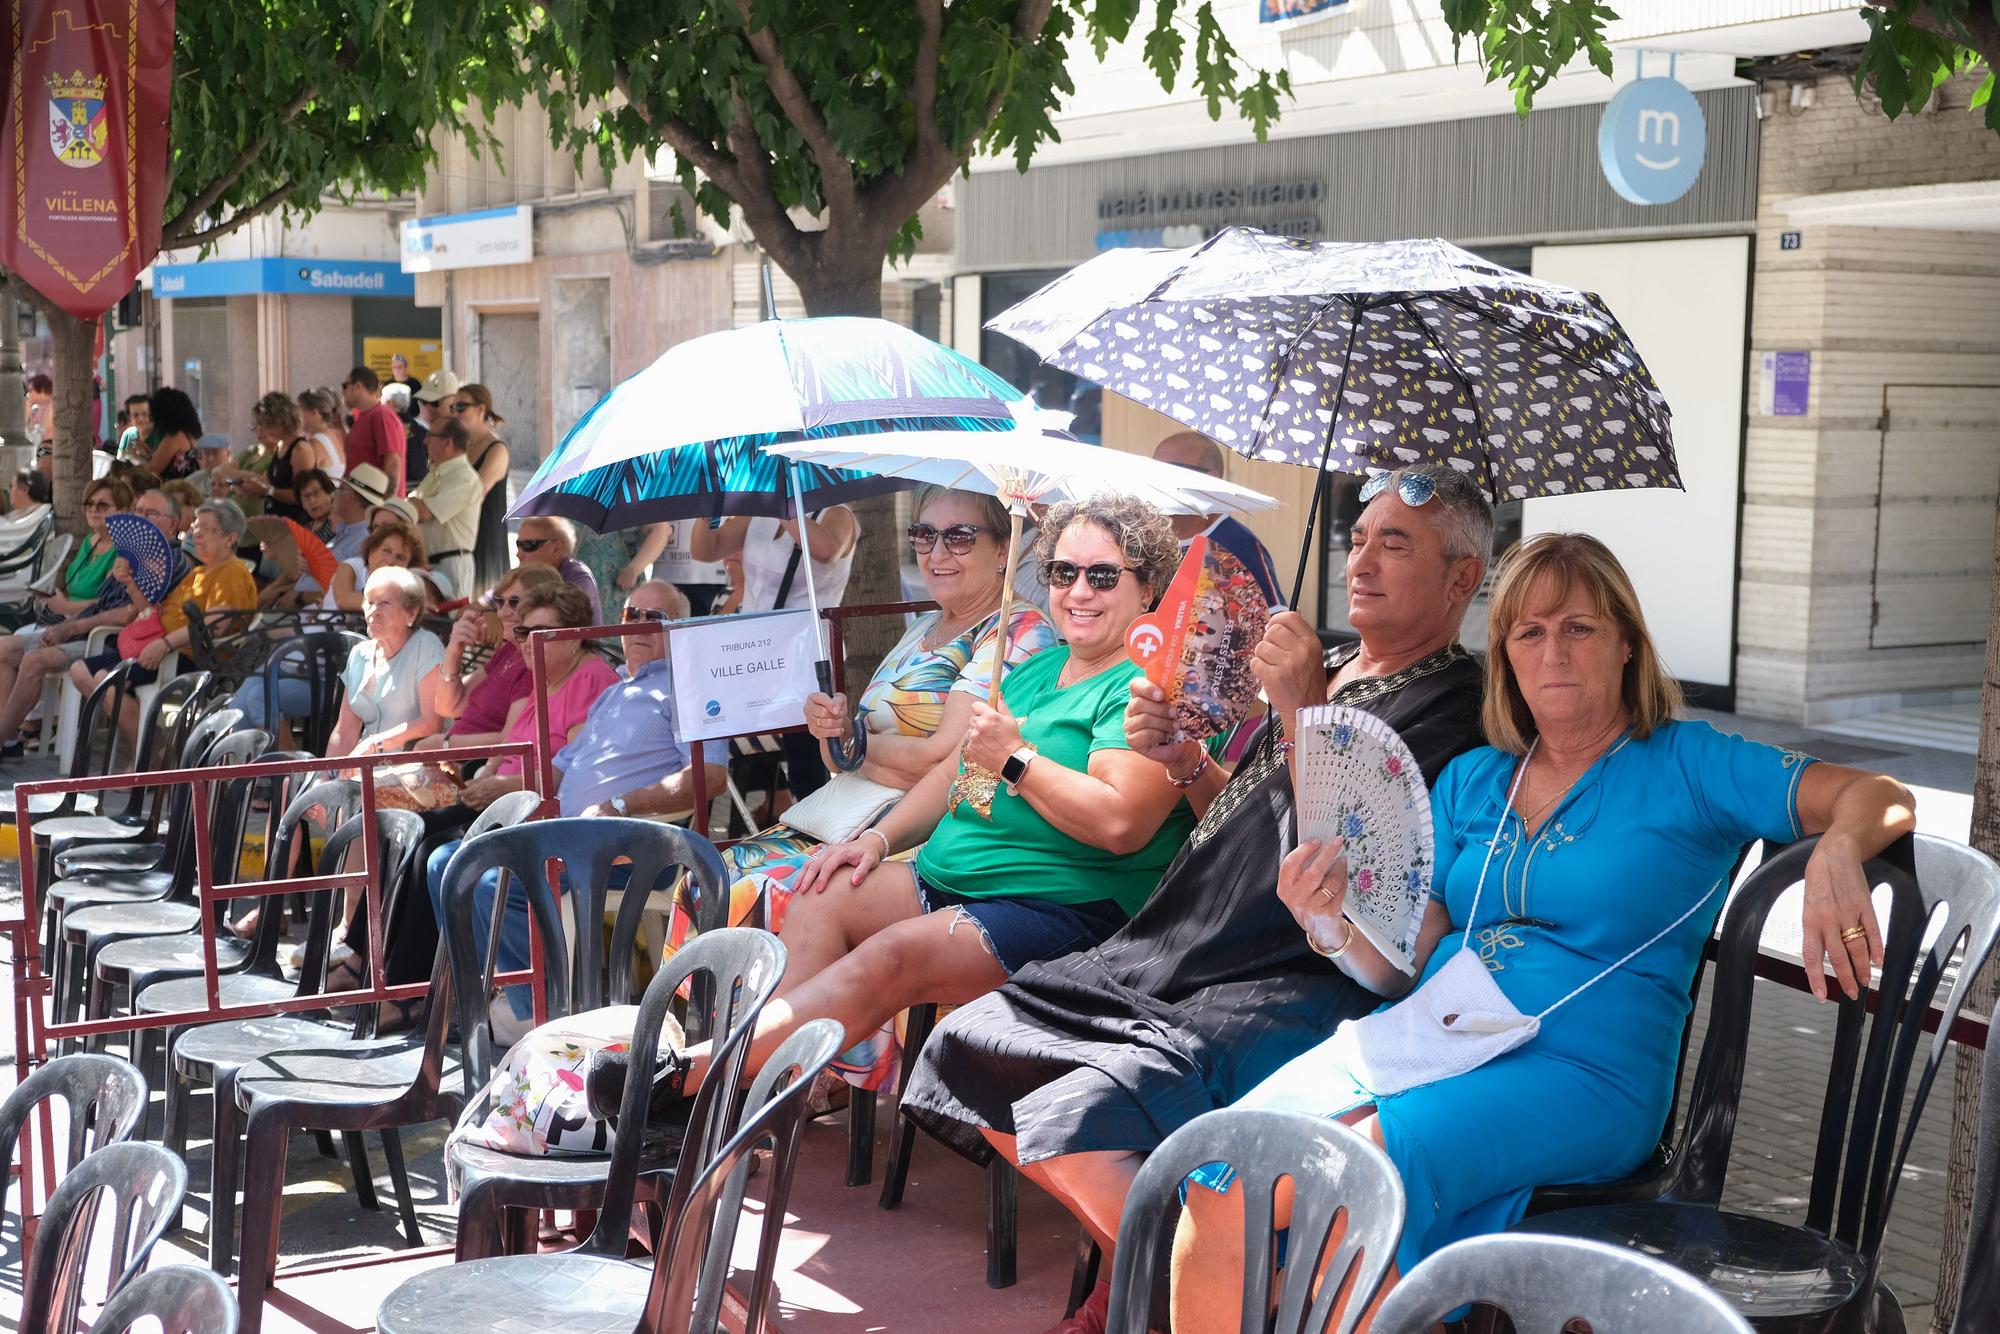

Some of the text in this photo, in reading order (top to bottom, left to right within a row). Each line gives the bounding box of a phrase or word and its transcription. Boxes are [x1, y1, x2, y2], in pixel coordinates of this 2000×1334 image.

[1638, 109, 1680, 147] m
[45, 197, 118, 213] VILLENA
[310, 269, 384, 290] Sabadell
[1173, 599, 1186, 630] VILLENA
[720, 638, 772, 653] TRIBUNA 212
[1218, 619, 1234, 656] FELICES
[710, 658, 785, 678] VILLE GALLE
